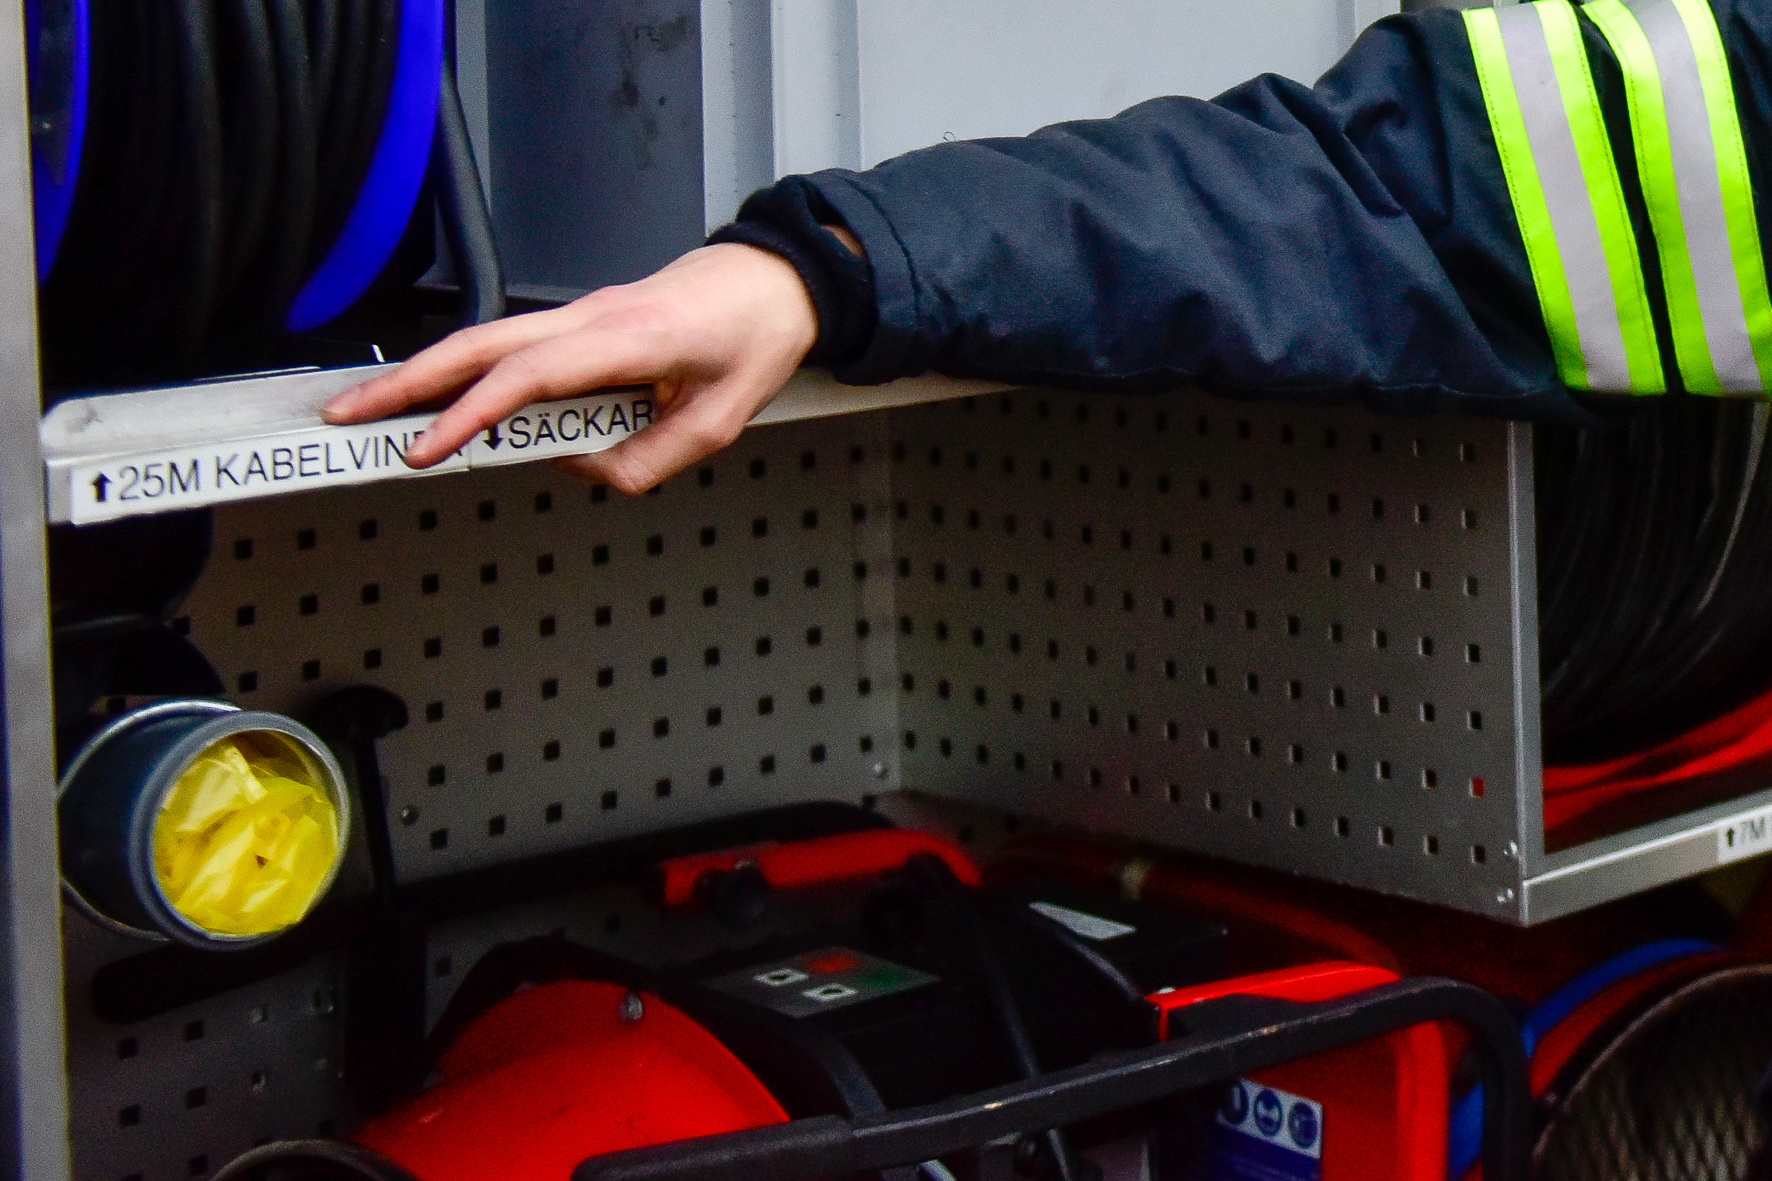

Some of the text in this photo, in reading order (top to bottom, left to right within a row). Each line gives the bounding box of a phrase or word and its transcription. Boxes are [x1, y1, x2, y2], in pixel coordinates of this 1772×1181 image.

[507, 398, 653, 450] SÄCKAR
[118, 428, 463, 501] 25M KABELVIN
